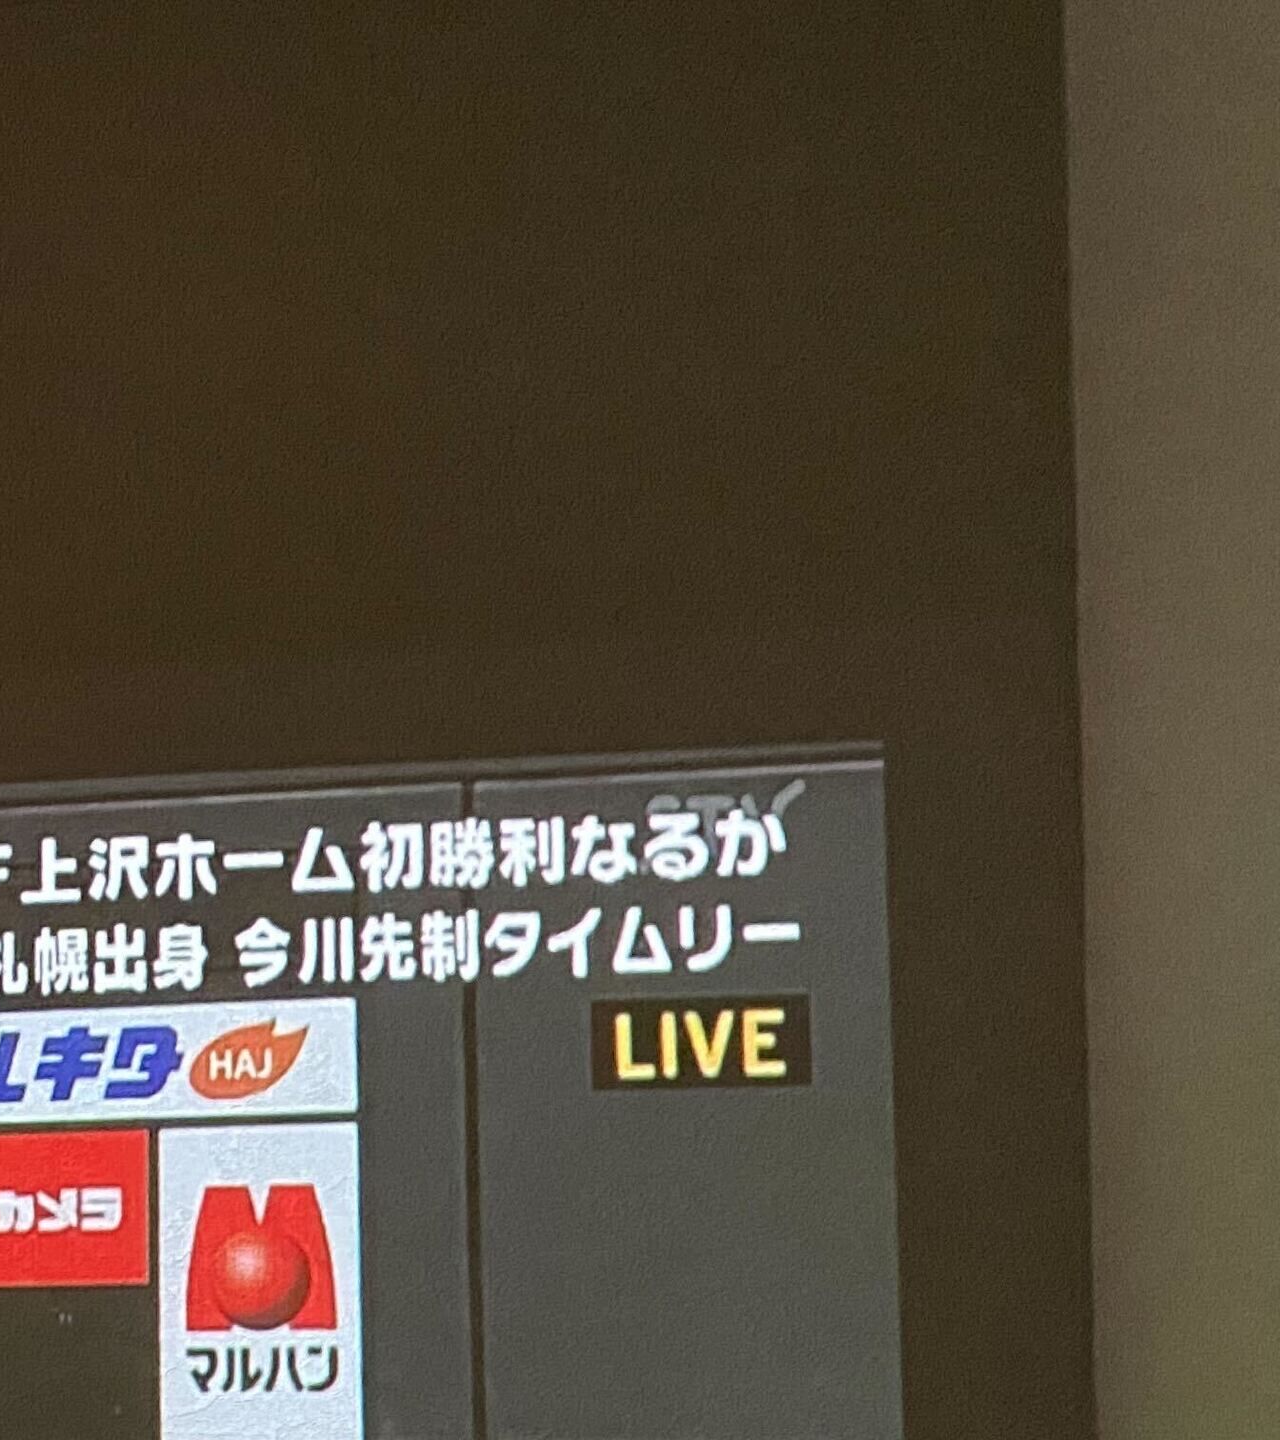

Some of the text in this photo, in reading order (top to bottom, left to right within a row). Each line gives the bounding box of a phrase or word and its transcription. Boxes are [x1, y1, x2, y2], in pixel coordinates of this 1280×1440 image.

[235, 902, 801, 986] 今川先制タイムリー
[209, 1047, 274, 1082] HAJ
[614, 1008, 786, 1081] LIVE
[186, 1346, 338, 1393] マルハン
